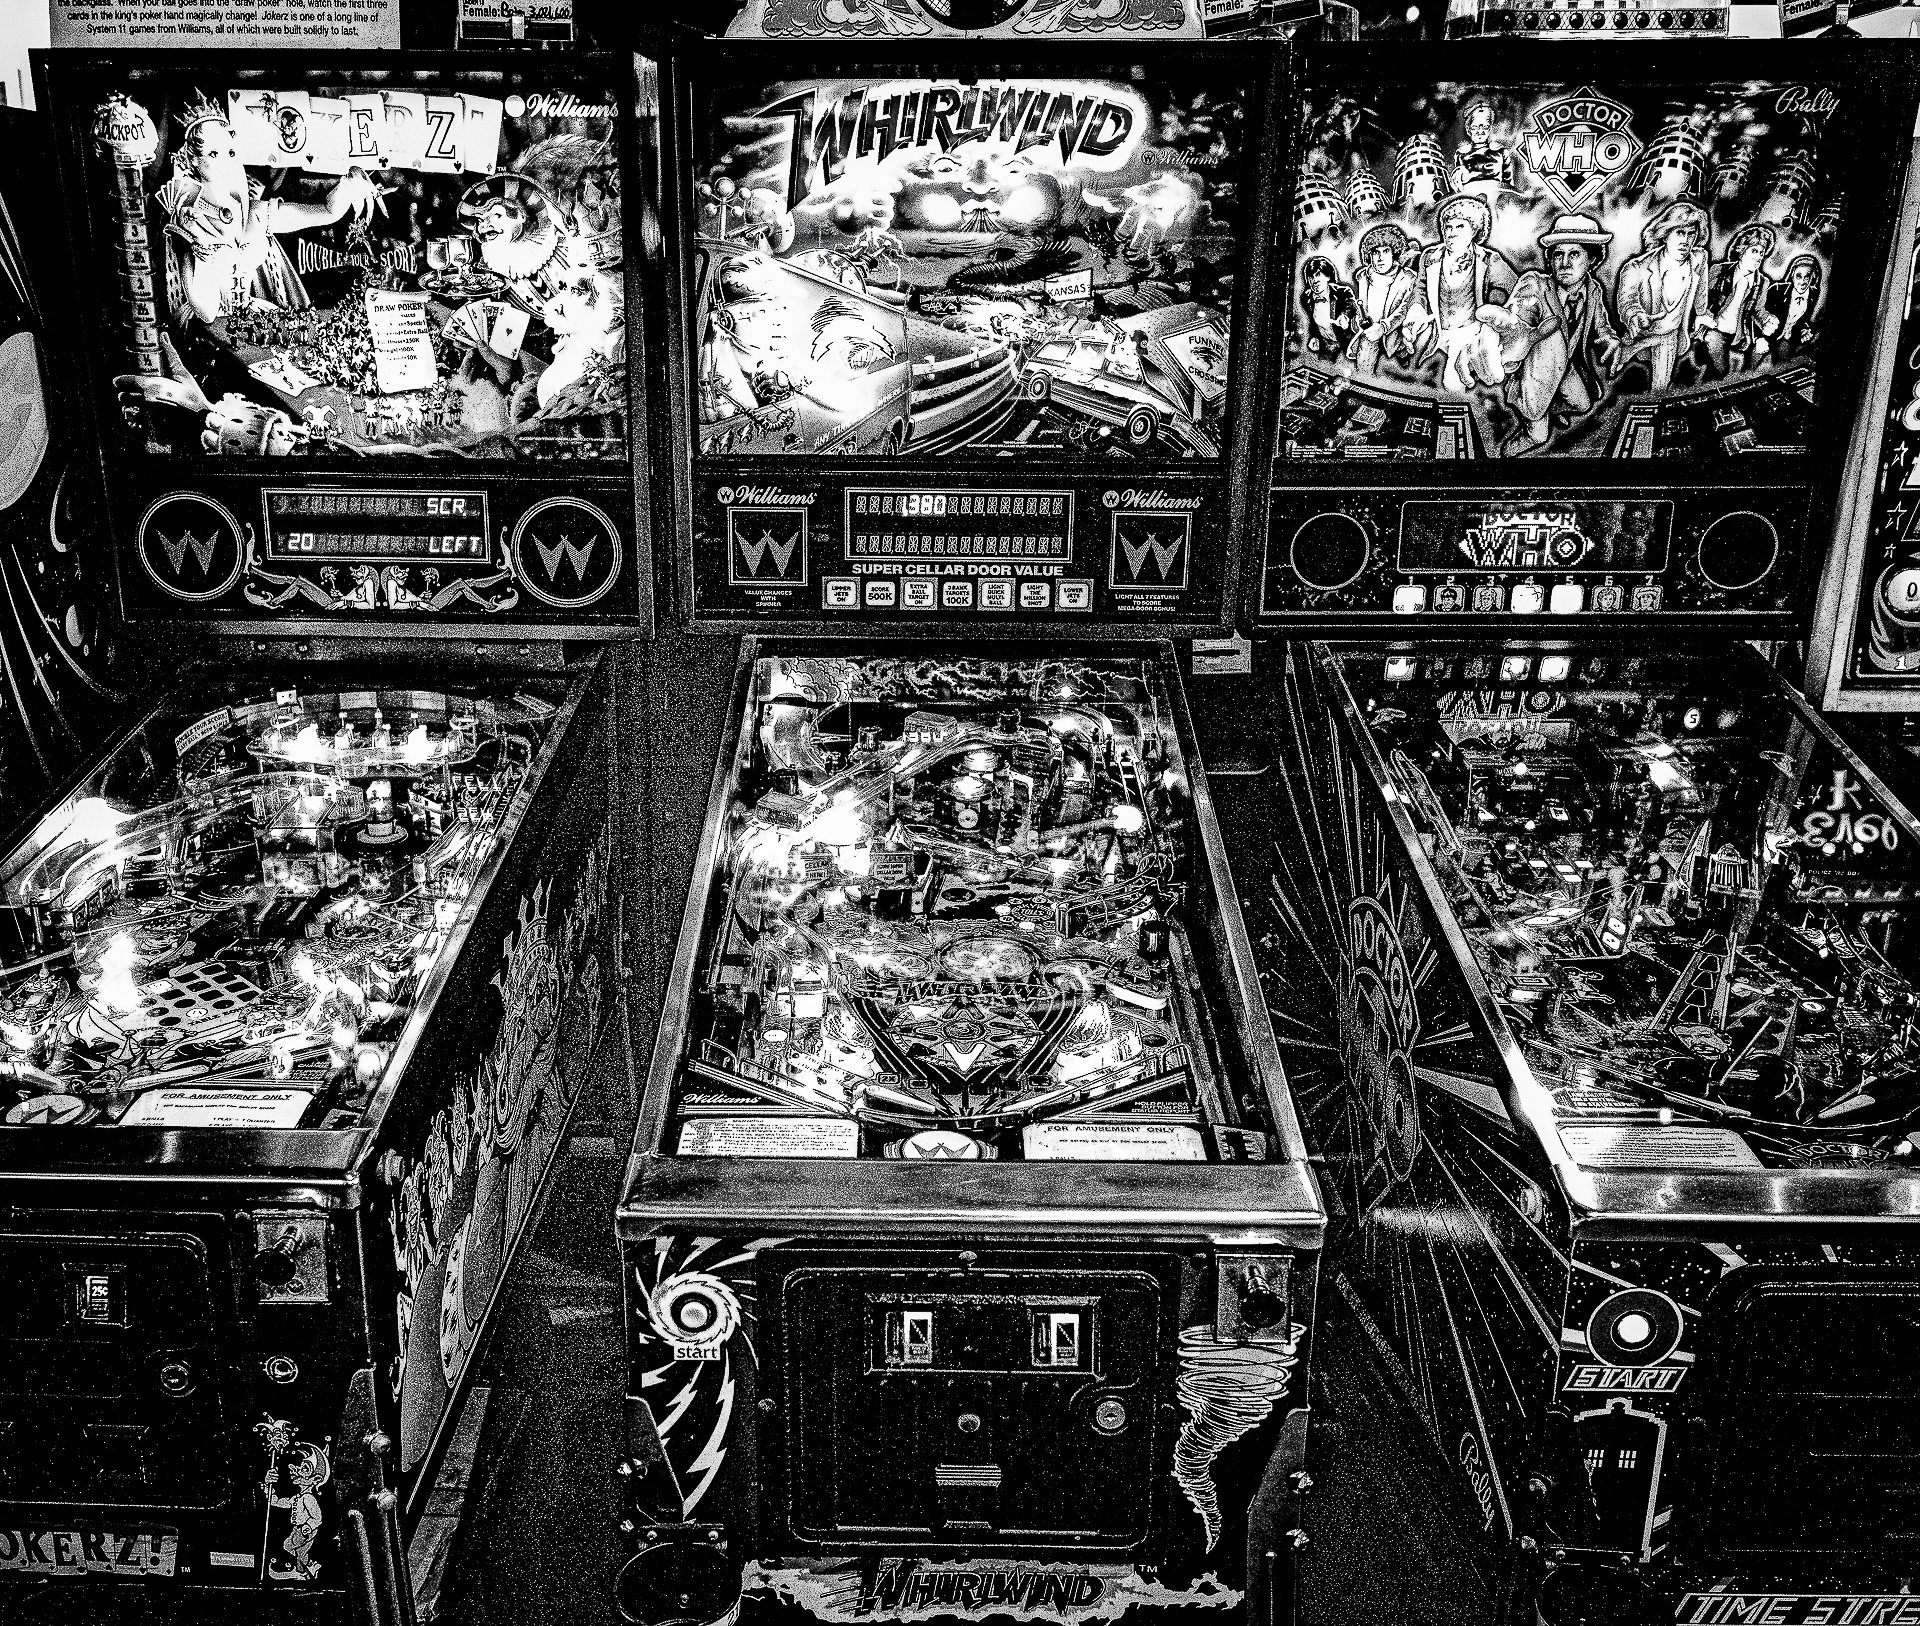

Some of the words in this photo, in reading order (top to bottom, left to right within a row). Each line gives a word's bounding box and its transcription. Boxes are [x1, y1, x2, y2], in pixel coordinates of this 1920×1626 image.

[67, 11, 89, 21] cards
[91, 10, 98, 20] in
[100, 11, 113, 20] the
[115, 11, 138, 22] king's
[139, 12, 162, 22] poker
[164, 11, 183, 20] hand
[186, 10, 223, 22] magically
[226, 11, 257, 22] change!
[261, 12, 289, 21] Jokerz
[291, 12, 298, 21] is
[317, 12, 326, 22] of
[334, 12, 351, 23] long
[354, 12, 368, 22] line
[370, 13, 379, 22] of
[463, 6, 500, 17] Female:
[86, 24, 116, 35] System
[129, 26, 156, 35] games
[158, 24, 176, 34] from
[178, 24, 213, 35] Williams,
[216, 24, 224, 34] all
[227, 24, 235, 34] of
[237, 24, 260, 34] which
[263, 26, 282, 34] were
[284, 25, 302, 35] built
[303, 26, 329, 36] solidly
[331, 26, 340, 35] to
[527, 93, 619, 117] Williams
[1775, 87, 1841, 119] Bally
[1542, 102, 1622, 129] DOCTOR
[752, 83, 1136, 213] WHIRLWIND
[1523, 131, 1632, 173] WHO
[298, 238, 343, 275] DOUBLE
[380, 244, 418, 275] SCORE
[1048, 283, 1088, 297] KANSAS
[374, 304, 396, 312] DRAW
[397, 303, 424, 311] POKER
[1188, 335, 1225, 356] FUNNEL
[736, 485, 816, 504] Williams
[1121, 488, 1201, 508] Williams
[286, 533, 314, 551] 20
[429, 535, 481, 553] LEFT
[1465, 527, 1589, 567] WHO
[852, 563, 903, 575] SUPER
[905, 564, 965, 576] CELLAR
[967, 564, 1012, 576] DOOR
[1013, 565, 1064, 577] VALUE
[1486, 575, 1495, 586] 3
[1524, 575, 1534, 586] 4
[1565, 575, 1574, 586] 5
[868, 592, 893, 600] 500K
[946, 596, 969, 605] 100K
[683, 1093, 761, 1104] Williams
[1798, 1142, 1889, 1160] DOCOR
[674, 1345, 719, 1360] start
[1574, 1367, 1679, 1389] START
[1460, 1431, 1496, 1531] Bally
[856, 1558, 1106, 1616] WHIRLWIND
[1138, 1565, 1158, 1573] TM
[1689, 1596, 1799, 1625] TIME
